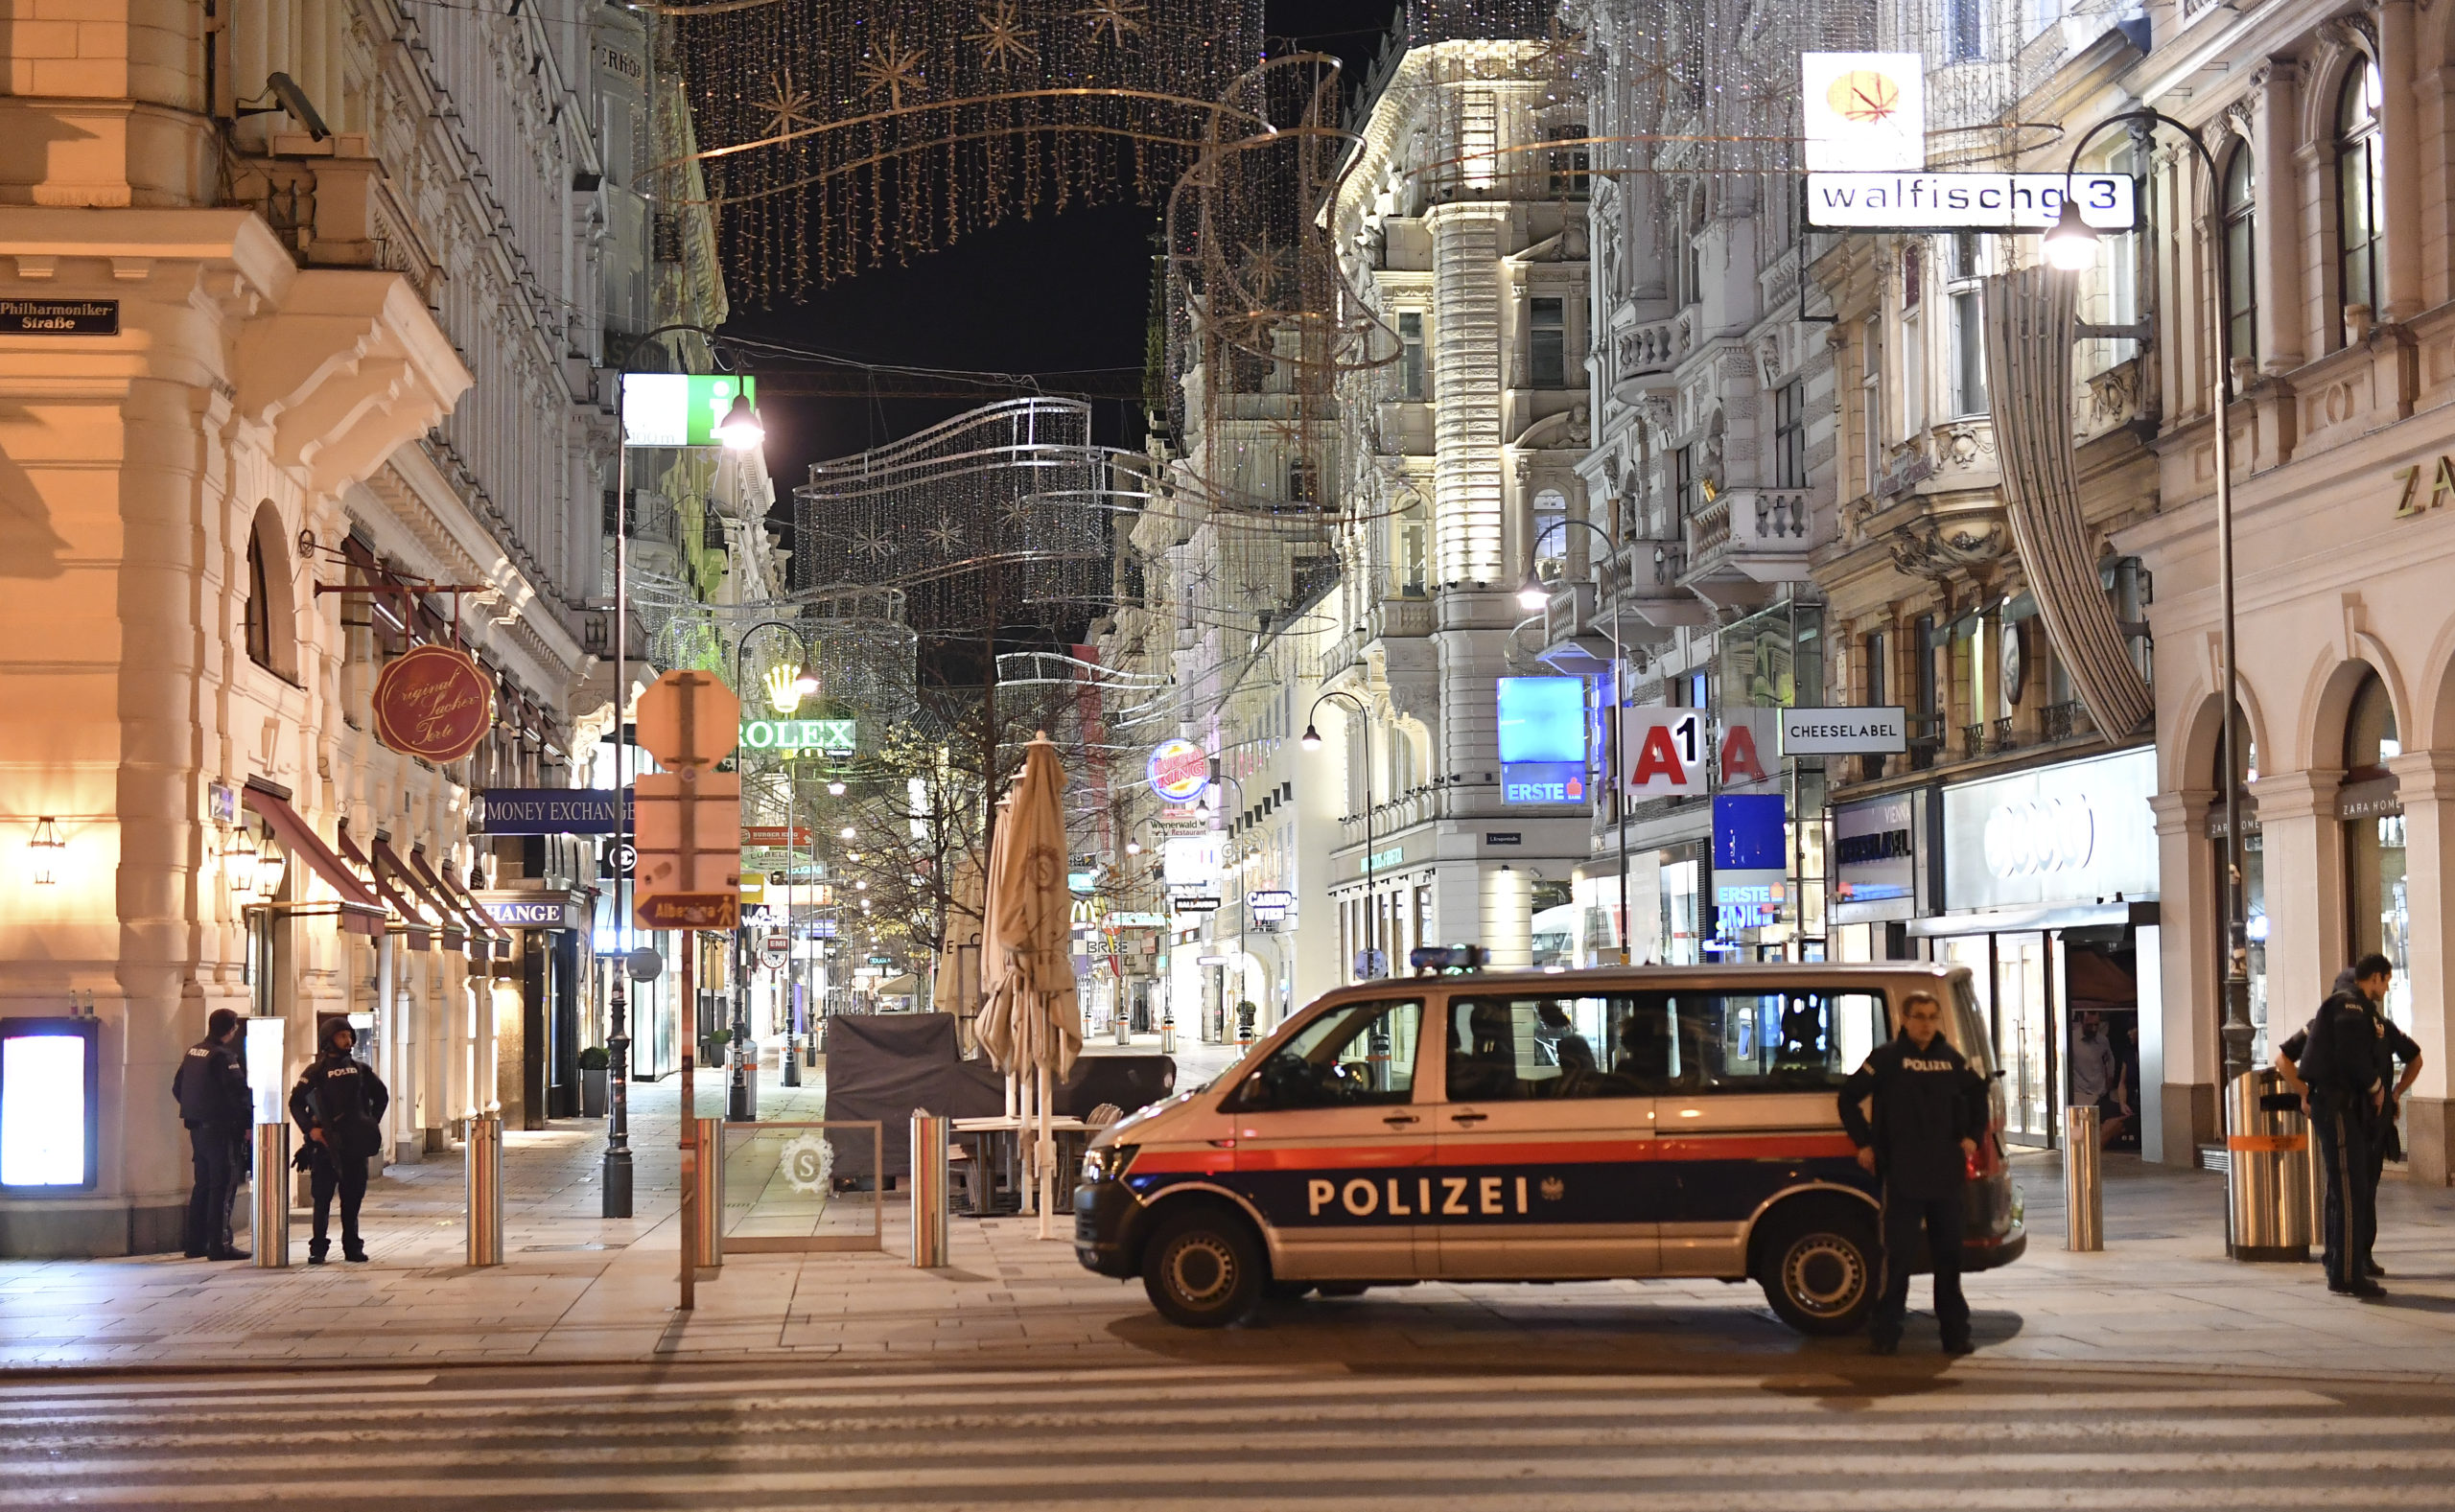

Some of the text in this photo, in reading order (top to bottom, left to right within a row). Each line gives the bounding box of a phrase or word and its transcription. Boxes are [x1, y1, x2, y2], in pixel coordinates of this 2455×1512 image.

[2089, 179, 2116, 209] 3
[0, 302, 114, 316] Philharmoniker-
[22, 316, 76, 329] Straße
[411, 713, 455, 746] Torte
[1790, 725, 1898, 738] CHEESELABEL
[1158, 759, 1204, 789] KING
[1508, 782, 1565, 801] ERSTE
[487, 802, 546, 821] MONEY
[2343, 798, 2401, 815] ZARA HOME
[1151, 821, 1198, 829] Wienerwald
[2211, 820, 2260, 834] ZAR OME
[1718, 886, 1769, 903] ERSTE
[481, 904, 560, 922] HANGE
[1087, 941, 1128, 953] BREE
[1308, 1176, 1529, 1217] POLIZEI
